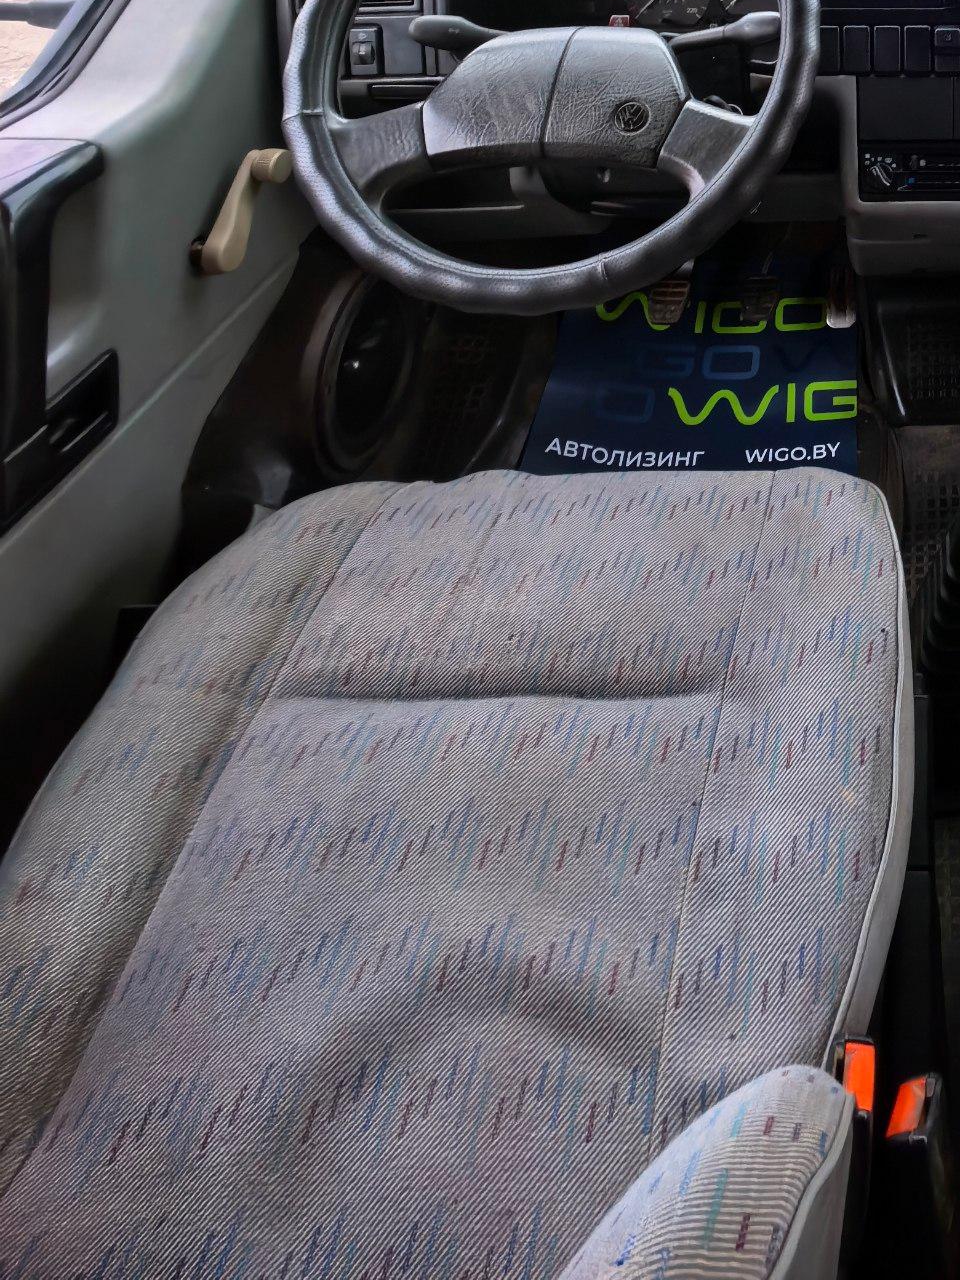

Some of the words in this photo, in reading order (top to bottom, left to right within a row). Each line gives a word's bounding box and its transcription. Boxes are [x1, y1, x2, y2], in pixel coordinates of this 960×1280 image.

[667, 379, 858, 426] WIG
[544, 436, 705, 468] АВТОЛИЗИНГ
[744, 441, 841, 464] WIGO.BY
